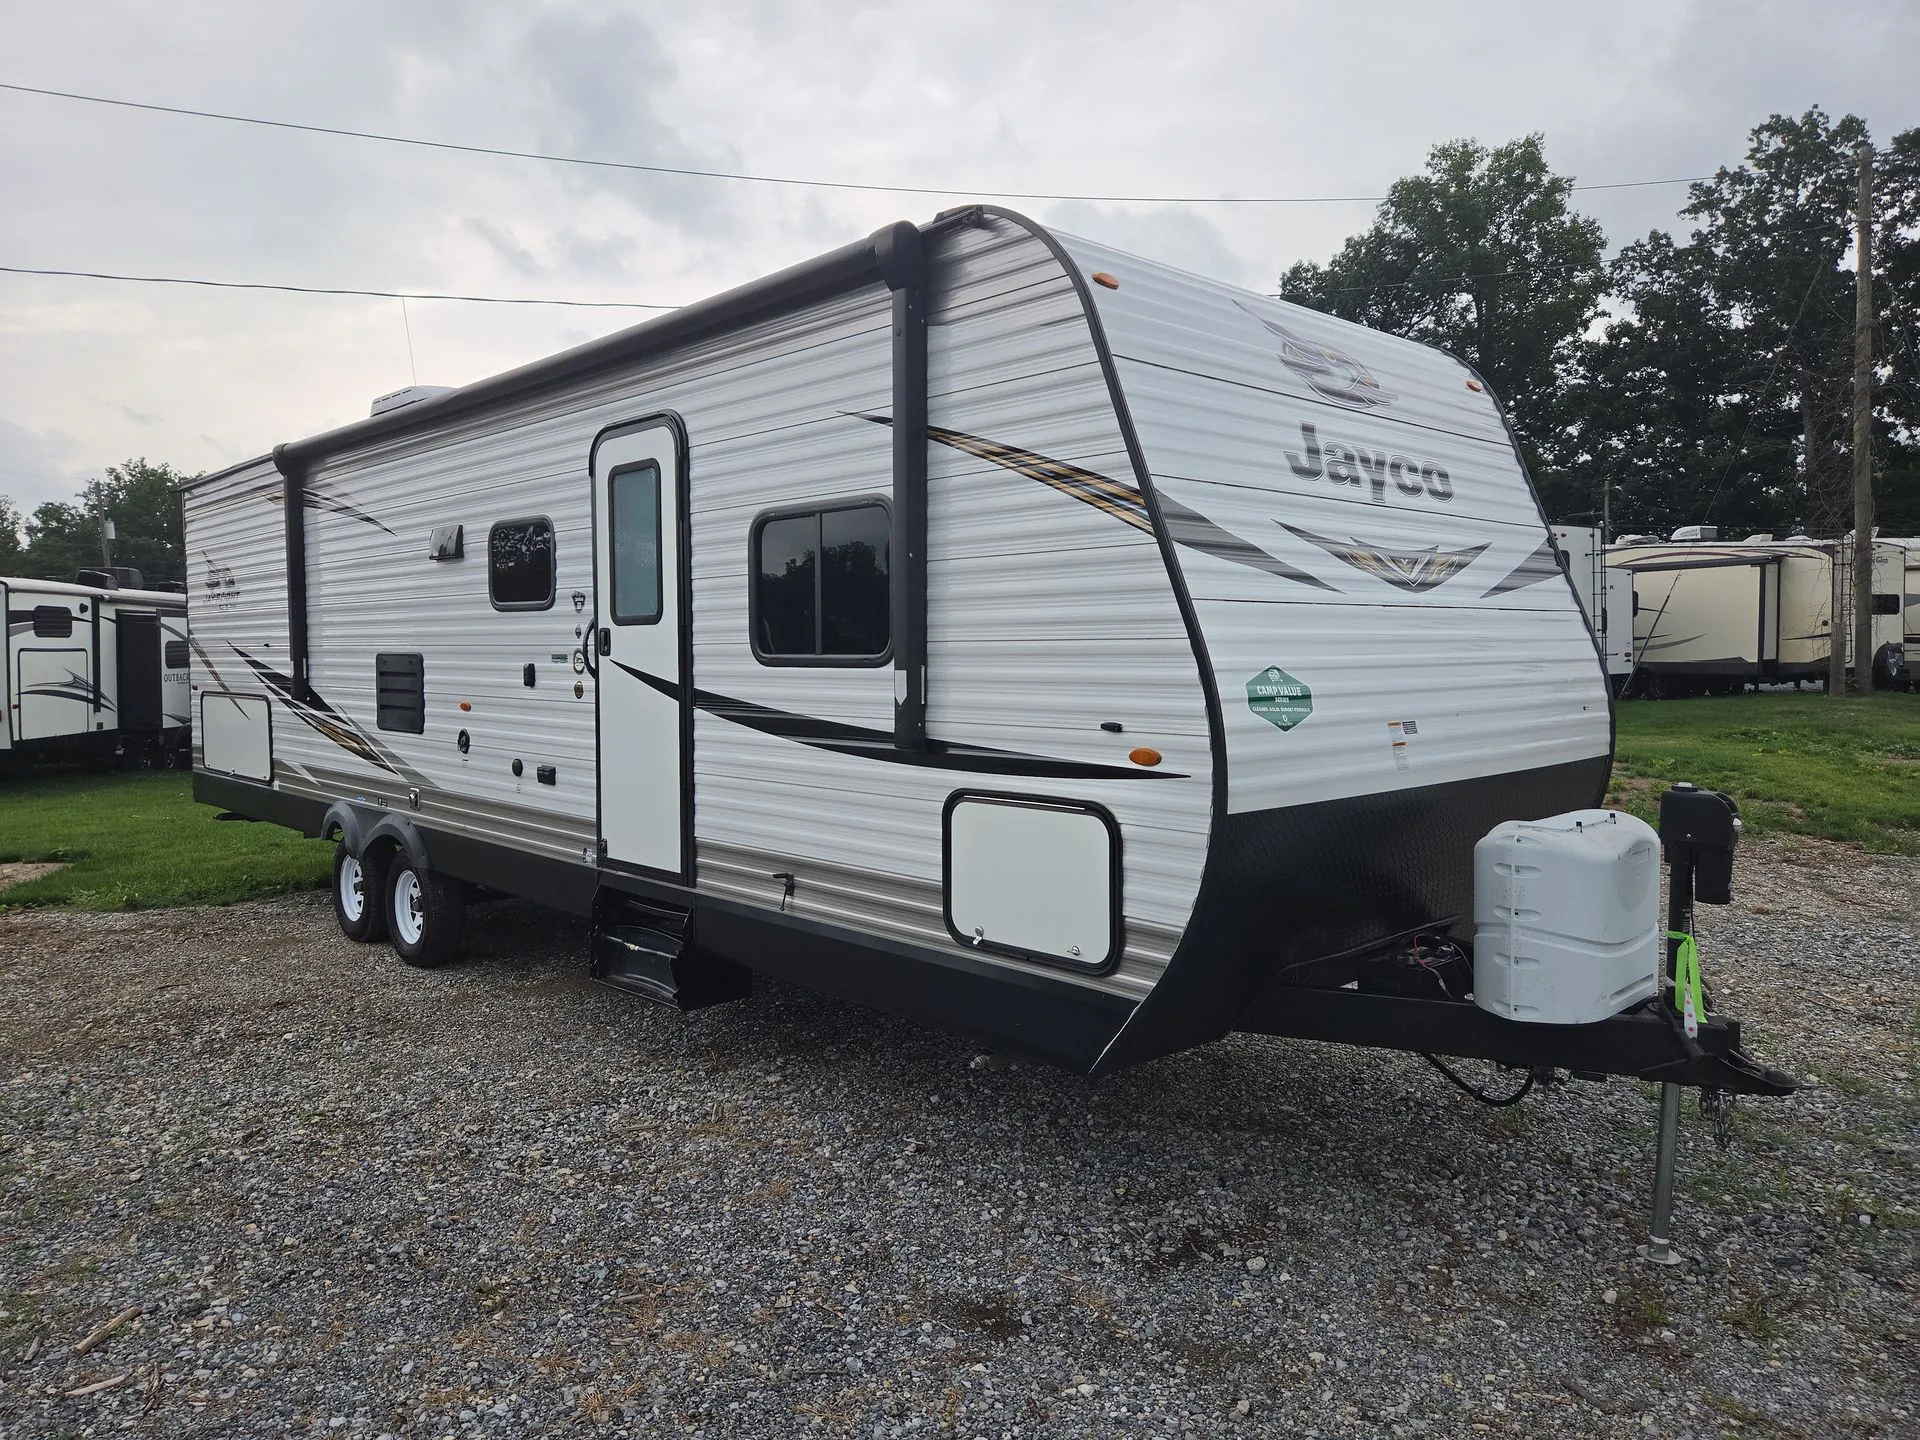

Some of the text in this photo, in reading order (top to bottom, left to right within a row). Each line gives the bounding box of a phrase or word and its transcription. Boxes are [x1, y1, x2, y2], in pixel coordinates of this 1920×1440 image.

[1284, 420, 1455, 503] Jayco
[1257, 685, 1302, 696] CAMP VALUE
